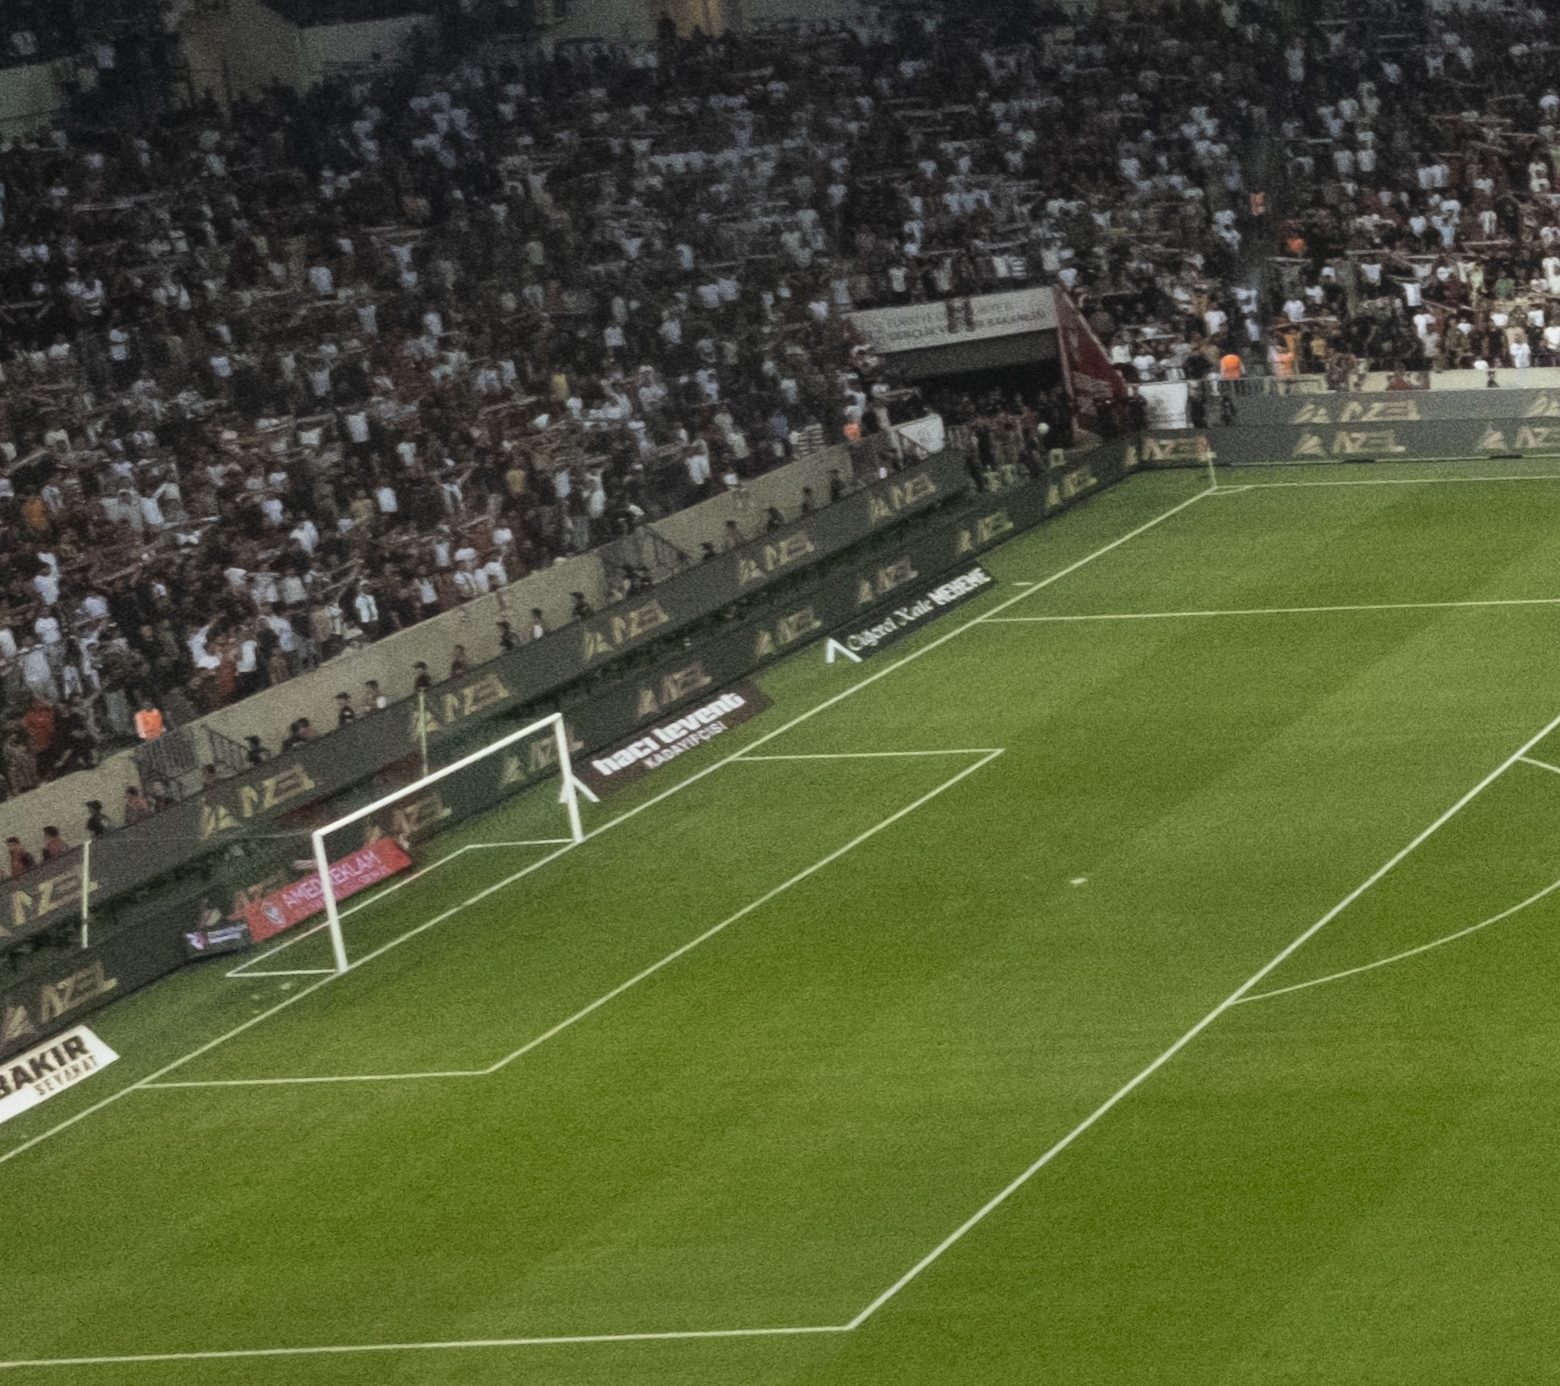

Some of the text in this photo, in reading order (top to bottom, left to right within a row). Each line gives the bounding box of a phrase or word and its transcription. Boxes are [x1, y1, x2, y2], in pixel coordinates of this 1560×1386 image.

[1341, 401, 1421, 421] AZEL
[1334, 432, 1405, 453] AZEL
[328, 849, 383, 884] EKLAM
